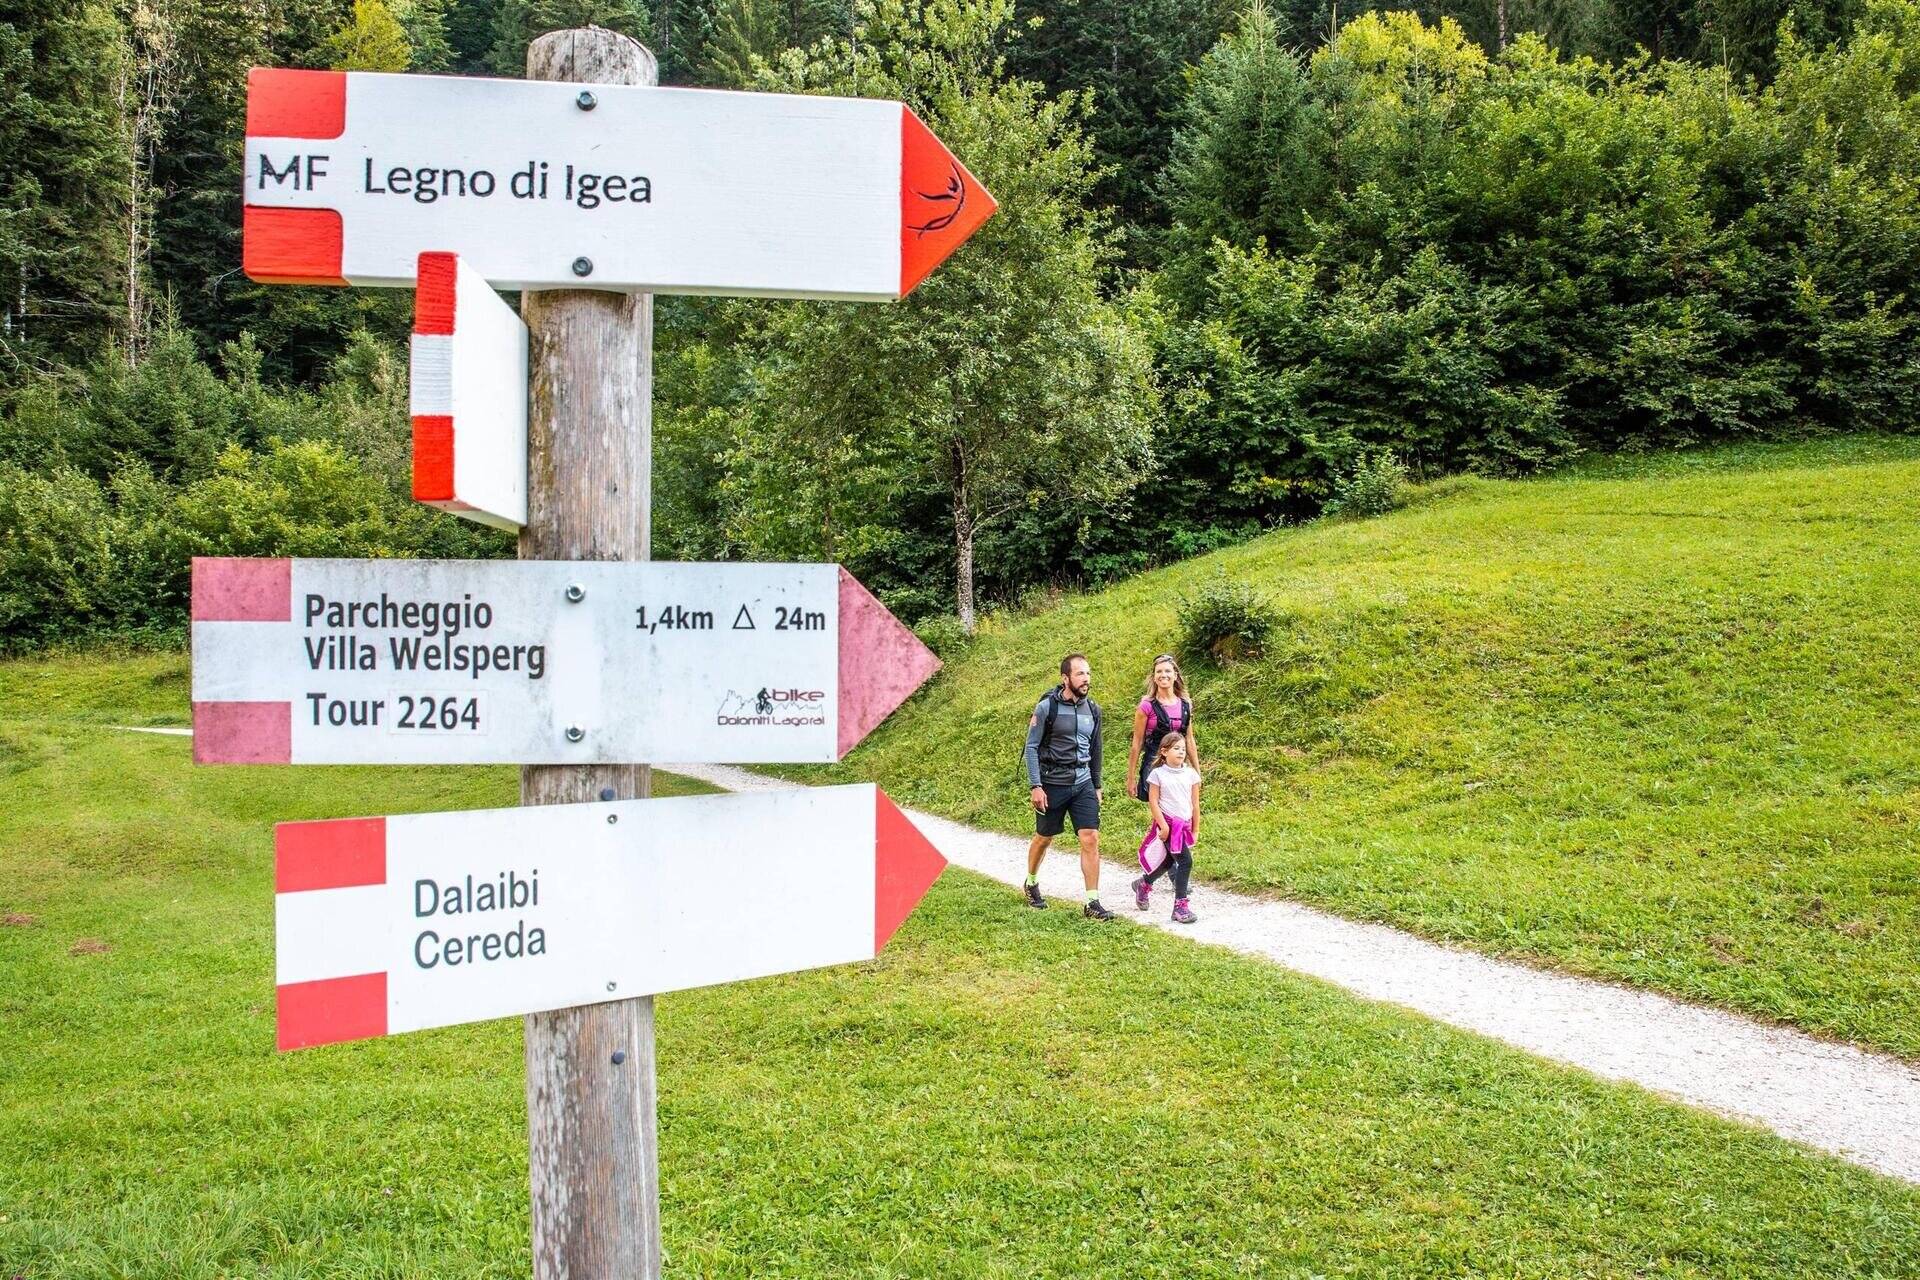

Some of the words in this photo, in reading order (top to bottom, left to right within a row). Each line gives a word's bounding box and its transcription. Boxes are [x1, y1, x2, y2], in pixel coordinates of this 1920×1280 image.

[258, 153, 330, 191] MF
[365, 157, 496, 204] Legno
[510, 160, 549, 200] di
[565, 164, 652, 210] Igea
[305, 593, 493, 636] Parcheggio
[636, 604, 714, 635] 1,4km
[774, 606, 825, 631] 24m
[303, 635, 377, 671] Villa
[388, 635, 545, 680] Welsperg
[306, 692, 385, 727] Tour
[397, 695, 480, 730] 2264
[771, 688, 825, 702] bike
[717, 715, 770, 726] Dolomiti
[772, 716, 825, 727] Lagorai
[415, 868, 538, 918] Dalaibi
[414, 919, 546, 969] Cereda
